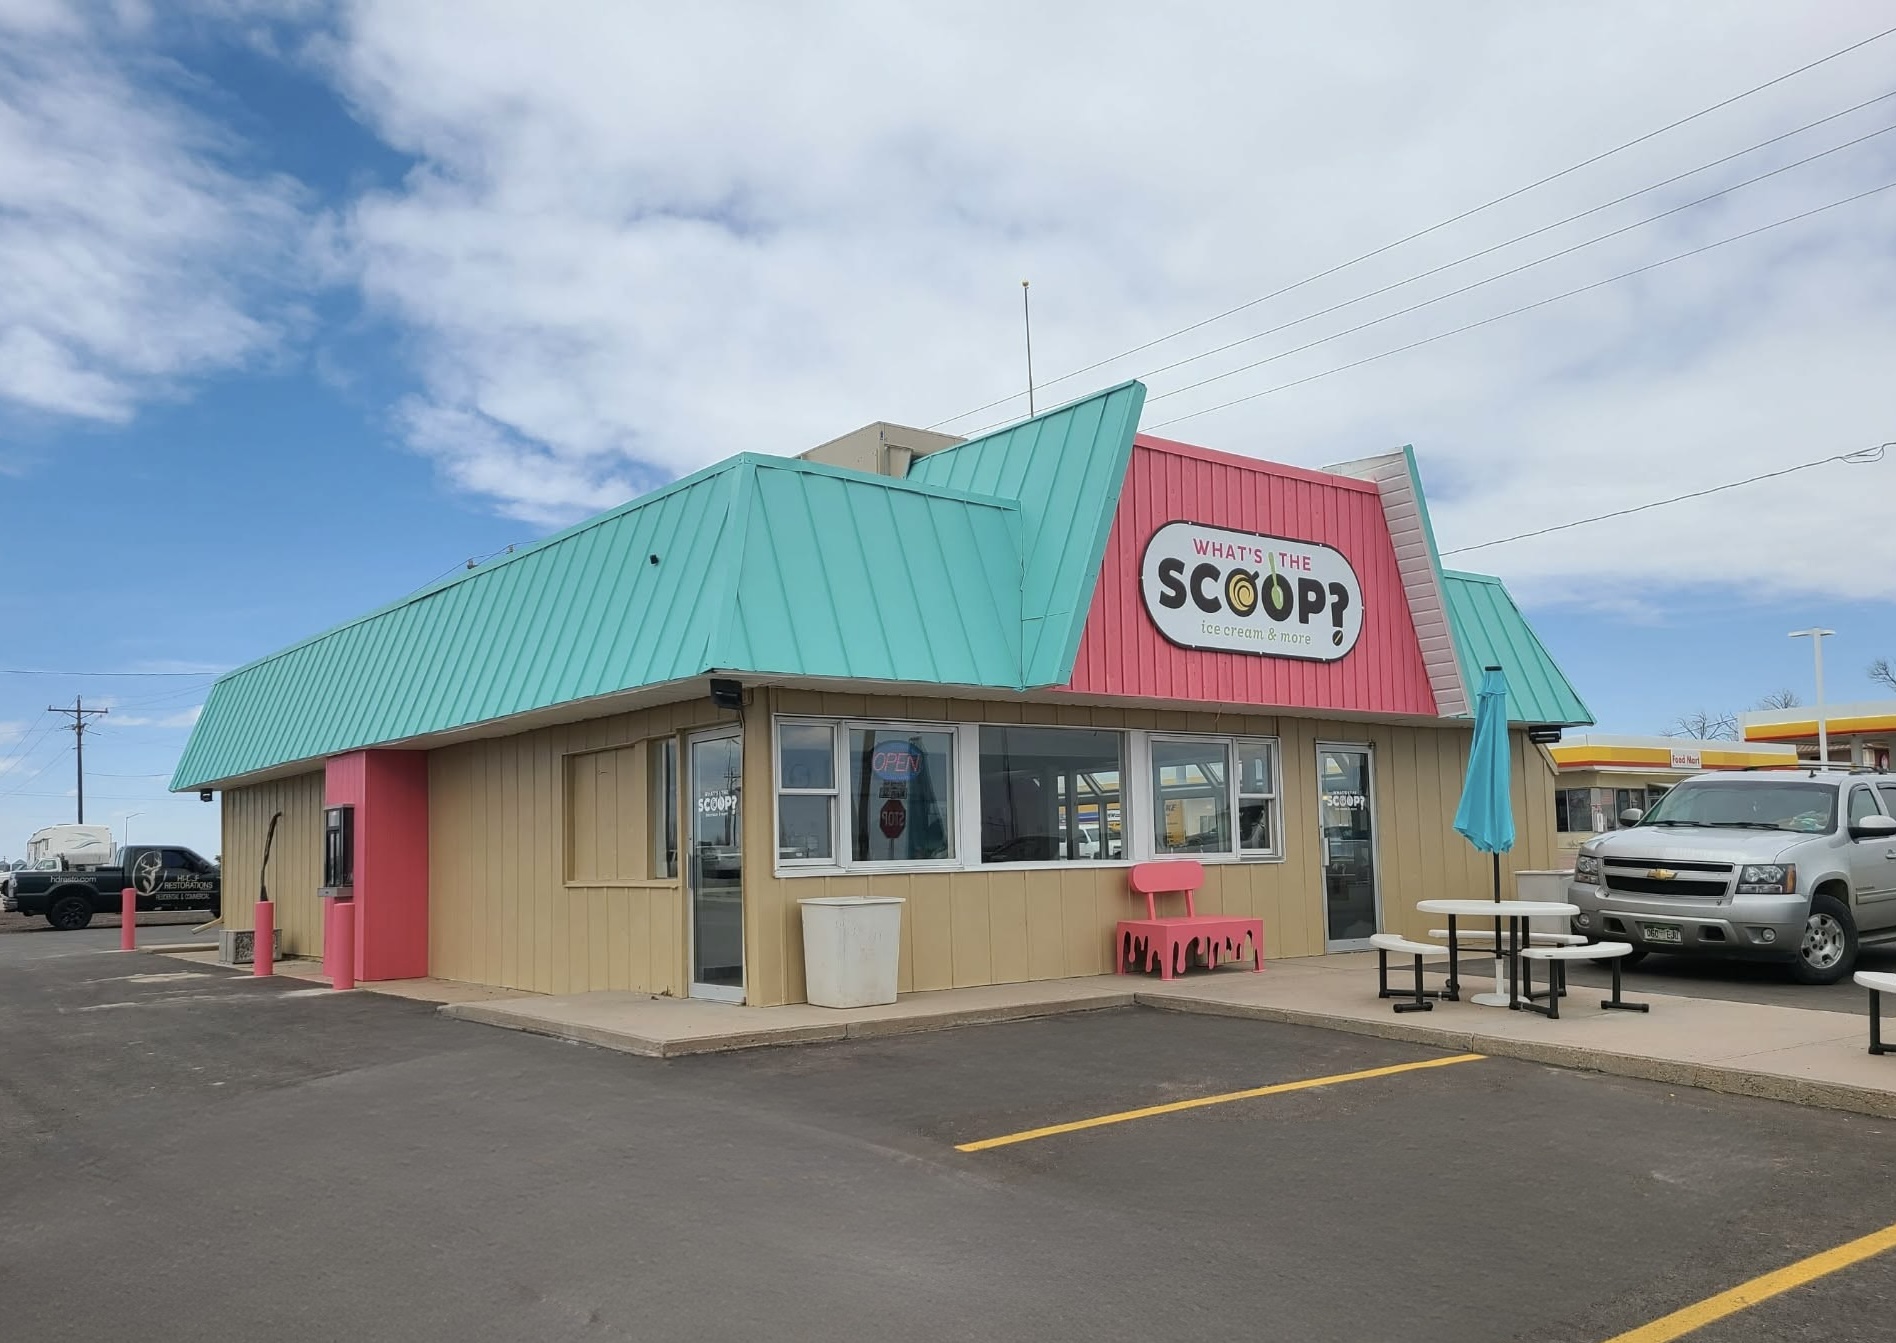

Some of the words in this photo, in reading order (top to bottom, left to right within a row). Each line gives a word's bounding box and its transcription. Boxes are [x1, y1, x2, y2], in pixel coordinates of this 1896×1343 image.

[1192, 537, 1263, 564] WHAT'S
[1278, 552, 1312, 571] THE
[1158, 557, 1350, 646] SCOOP?
[1201, 620, 1221, 635] ice
[1223, 624, 1265, 641] cream
[1267, 627, 1277, 641] &
[1280, 631, 1312, 645] more
[872, 752, 920, 772] OPEN
[1672, 754, 1686, 764] Food
[698, 795, 738, 815] SCOOP?
[1327, 795, 1365, 811] SCOOP?
[164, 881, 214, 890] RESTORATIONS
